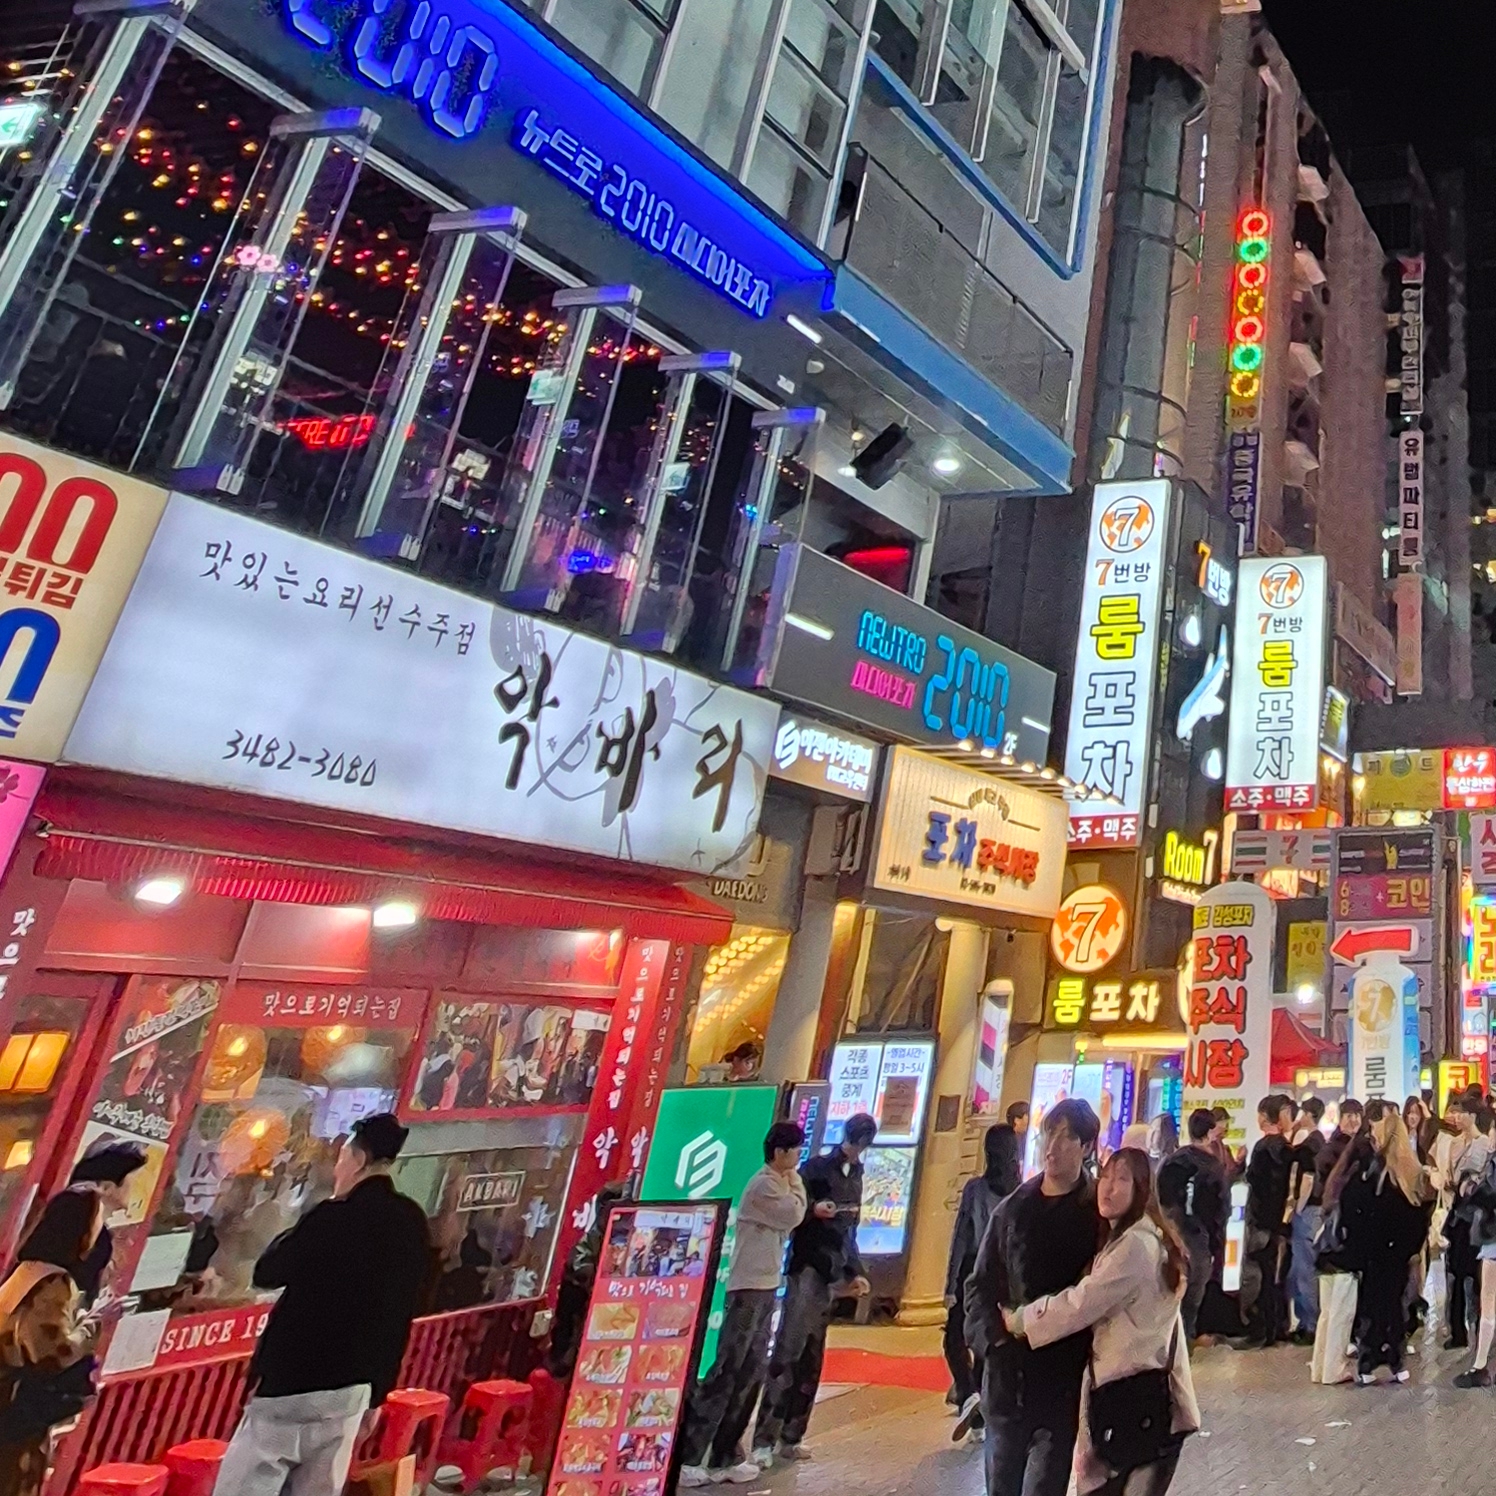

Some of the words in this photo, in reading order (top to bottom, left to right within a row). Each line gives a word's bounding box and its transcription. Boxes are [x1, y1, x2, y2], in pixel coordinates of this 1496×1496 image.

[1095, 559, 1151, 586] 7번방
[1198, 540, 1231, 607] 7번방
[857, 609, 927, 675] NEWTRO
[1257, 613, 1303, 634] 7번방
[923, 635, 1010, 749] 2010
[1253, 639, 1299, 781] 룸포차
[222, 729, 378, 788] 3482-3080
[922, 811, 978, 869] 포차
[1203, 829, 1219, 885] 7
[1386, 877, 1431, 910] 코인
[1071, 902, 1105, 962] 7
[1052, 979, 1161, 1024] 룸포차
[838, 1064, 869, 1081] 스포츠
[847, 1048, 868, 1064] 각종
[1185, 1038, 1250, 1089] 시장
[161, 1317, 234, 1356] SINCE
